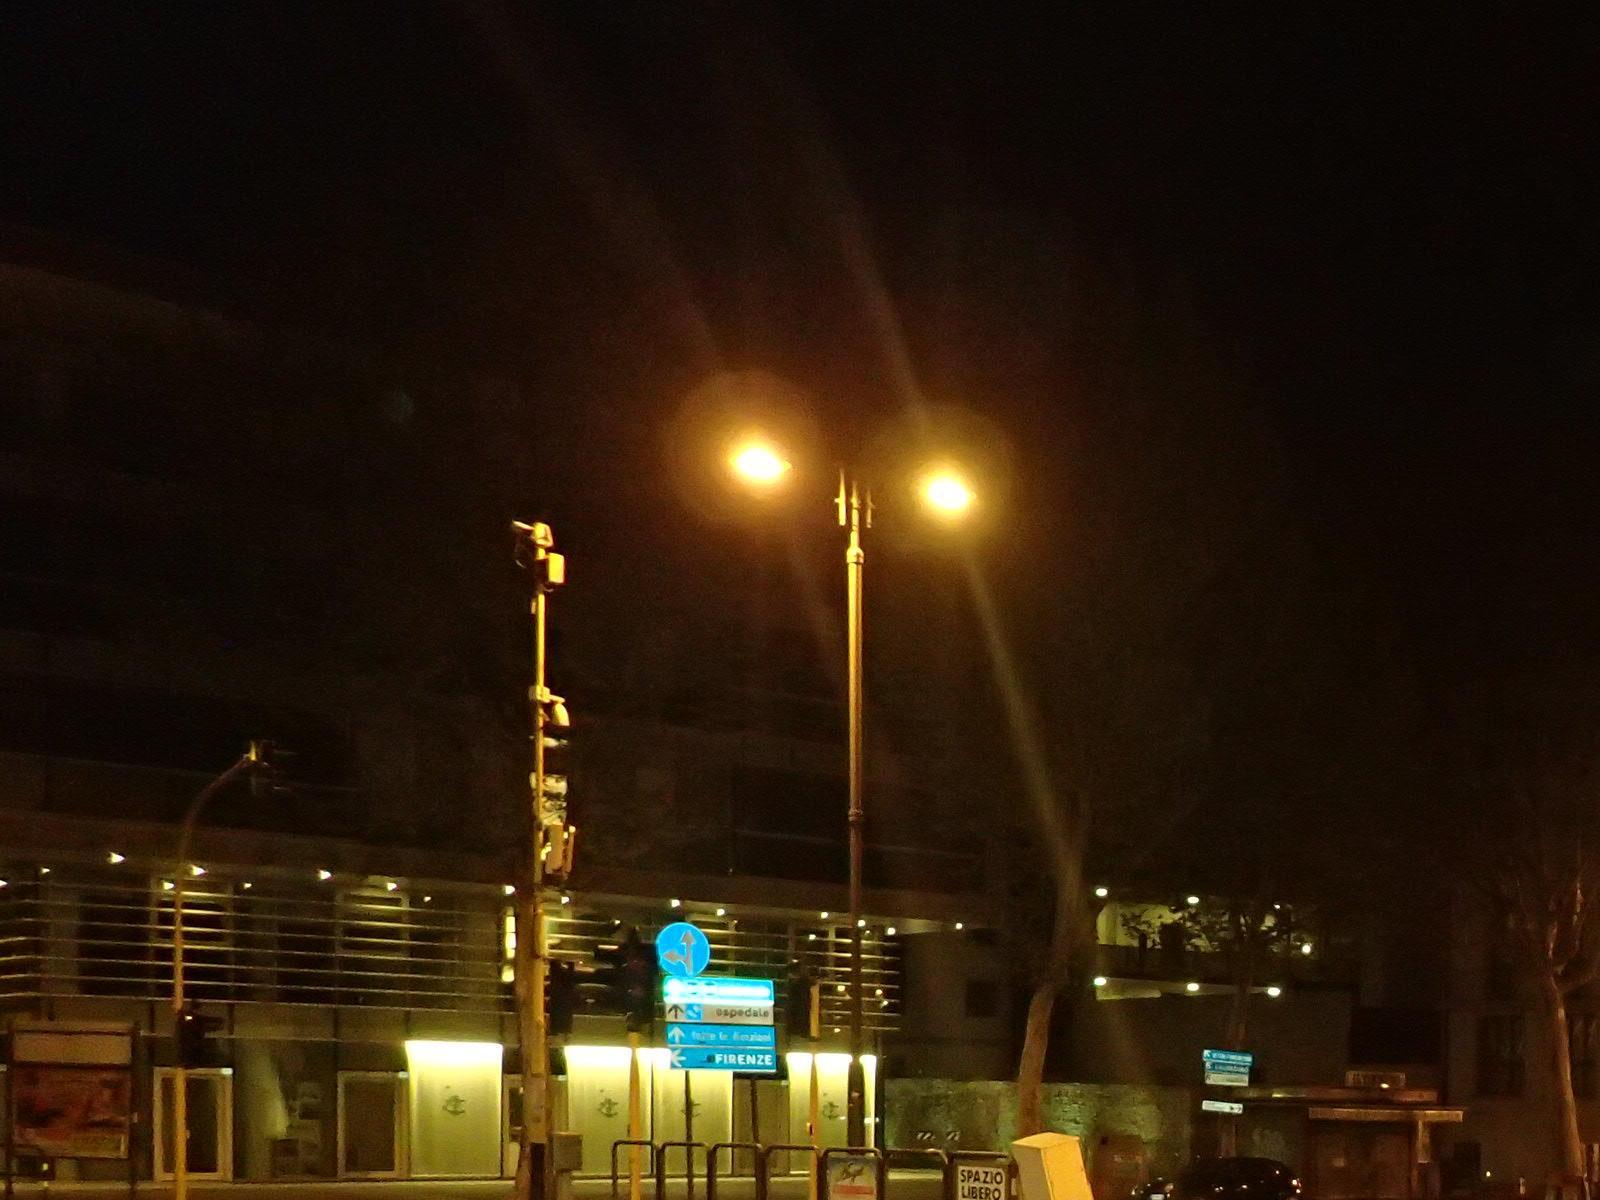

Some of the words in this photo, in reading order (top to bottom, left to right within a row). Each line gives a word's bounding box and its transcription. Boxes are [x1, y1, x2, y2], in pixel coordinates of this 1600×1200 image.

[715, 1007, 770, 1018] ospedale
[714, 1053, 773, 1066] FIRENZE
[959, 1168, 1004, 1185] SPAZIO
[961, 1185, 1002, 1200] LIBERO
